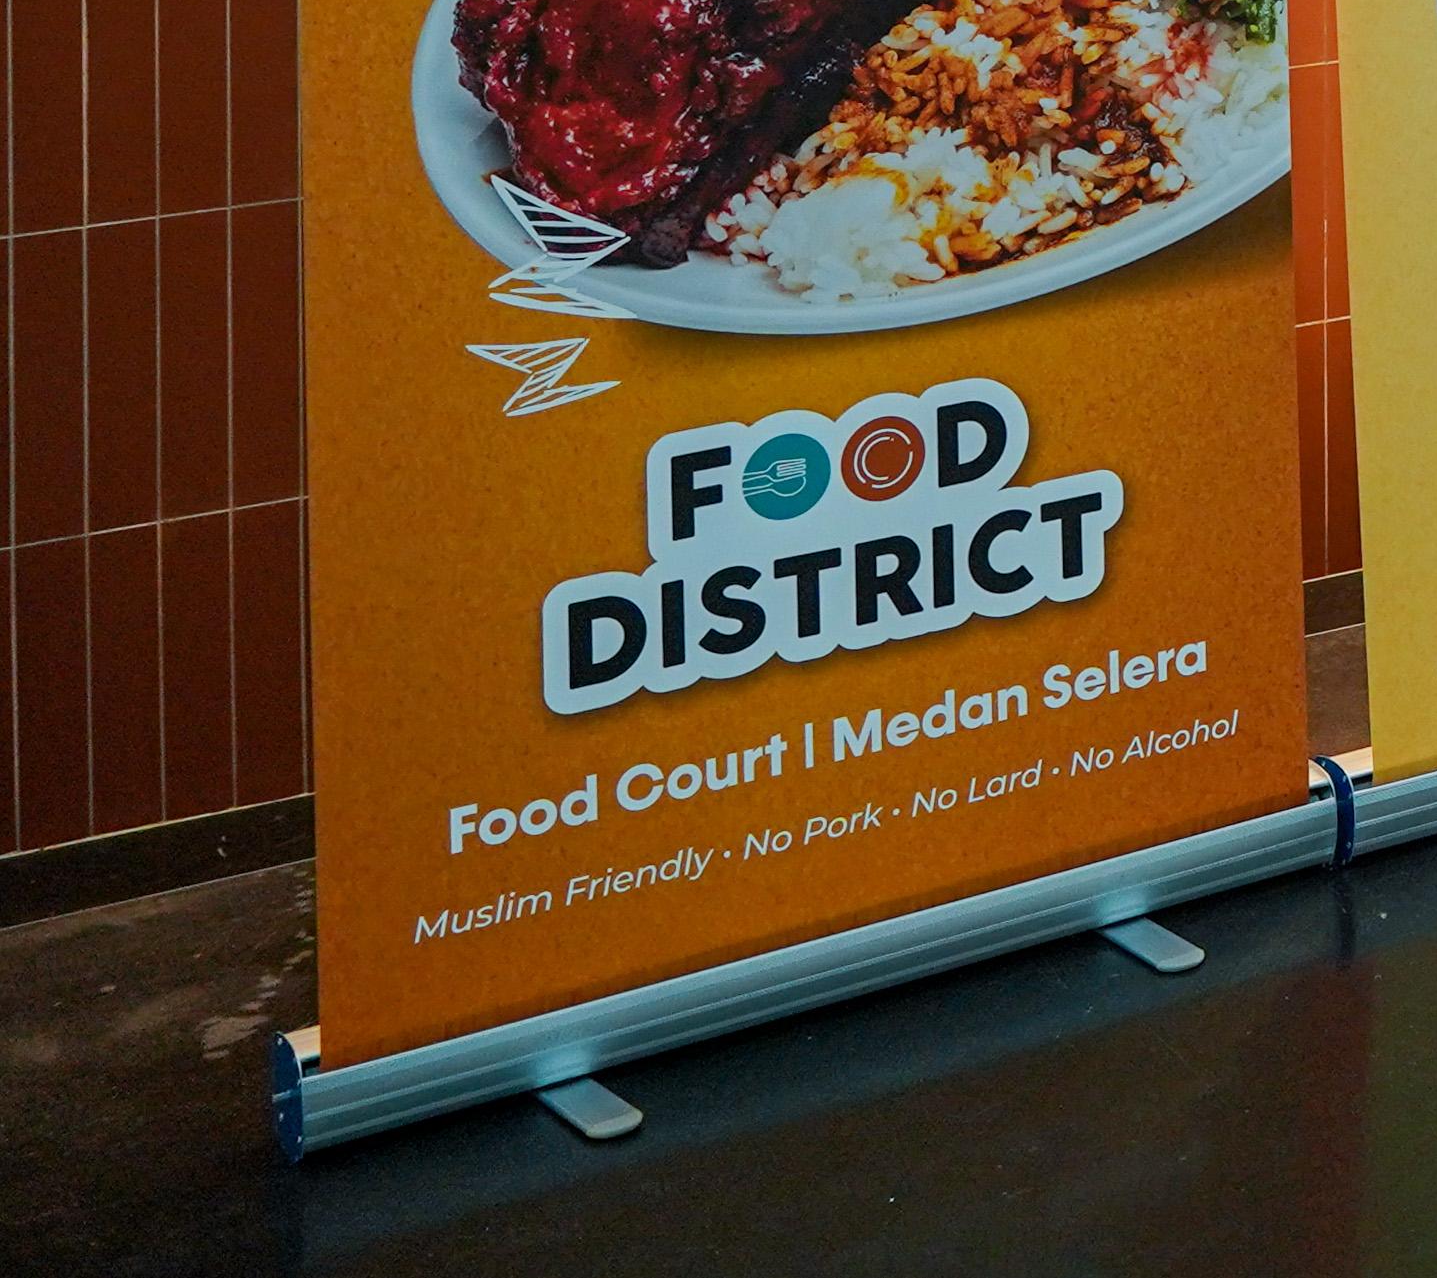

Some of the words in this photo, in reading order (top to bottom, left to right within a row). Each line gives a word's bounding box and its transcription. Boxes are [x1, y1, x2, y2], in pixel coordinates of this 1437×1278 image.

[670, 400, 1007, 542] FOOD
[567, 492, 1102, 690] DISTRICT
[413, 886, 552, 944] Muslim
[564, 845, 714, 909] Friendly
[741, 824, 793, 860] No
[802, 800, 882, 845] Pork
[910, 783, 960, 819] No
[966, 759, 1041, 806] Lard
[1069, 743, 1114, 778] No
[1121, 711, 1238, 766] Alcohol
[448, 774, 598, 855] Food
[616, 723, 788, 808] Court
[832, 682, 1028, 761] Medan
[1042, 640, 1207, 711] Selera
